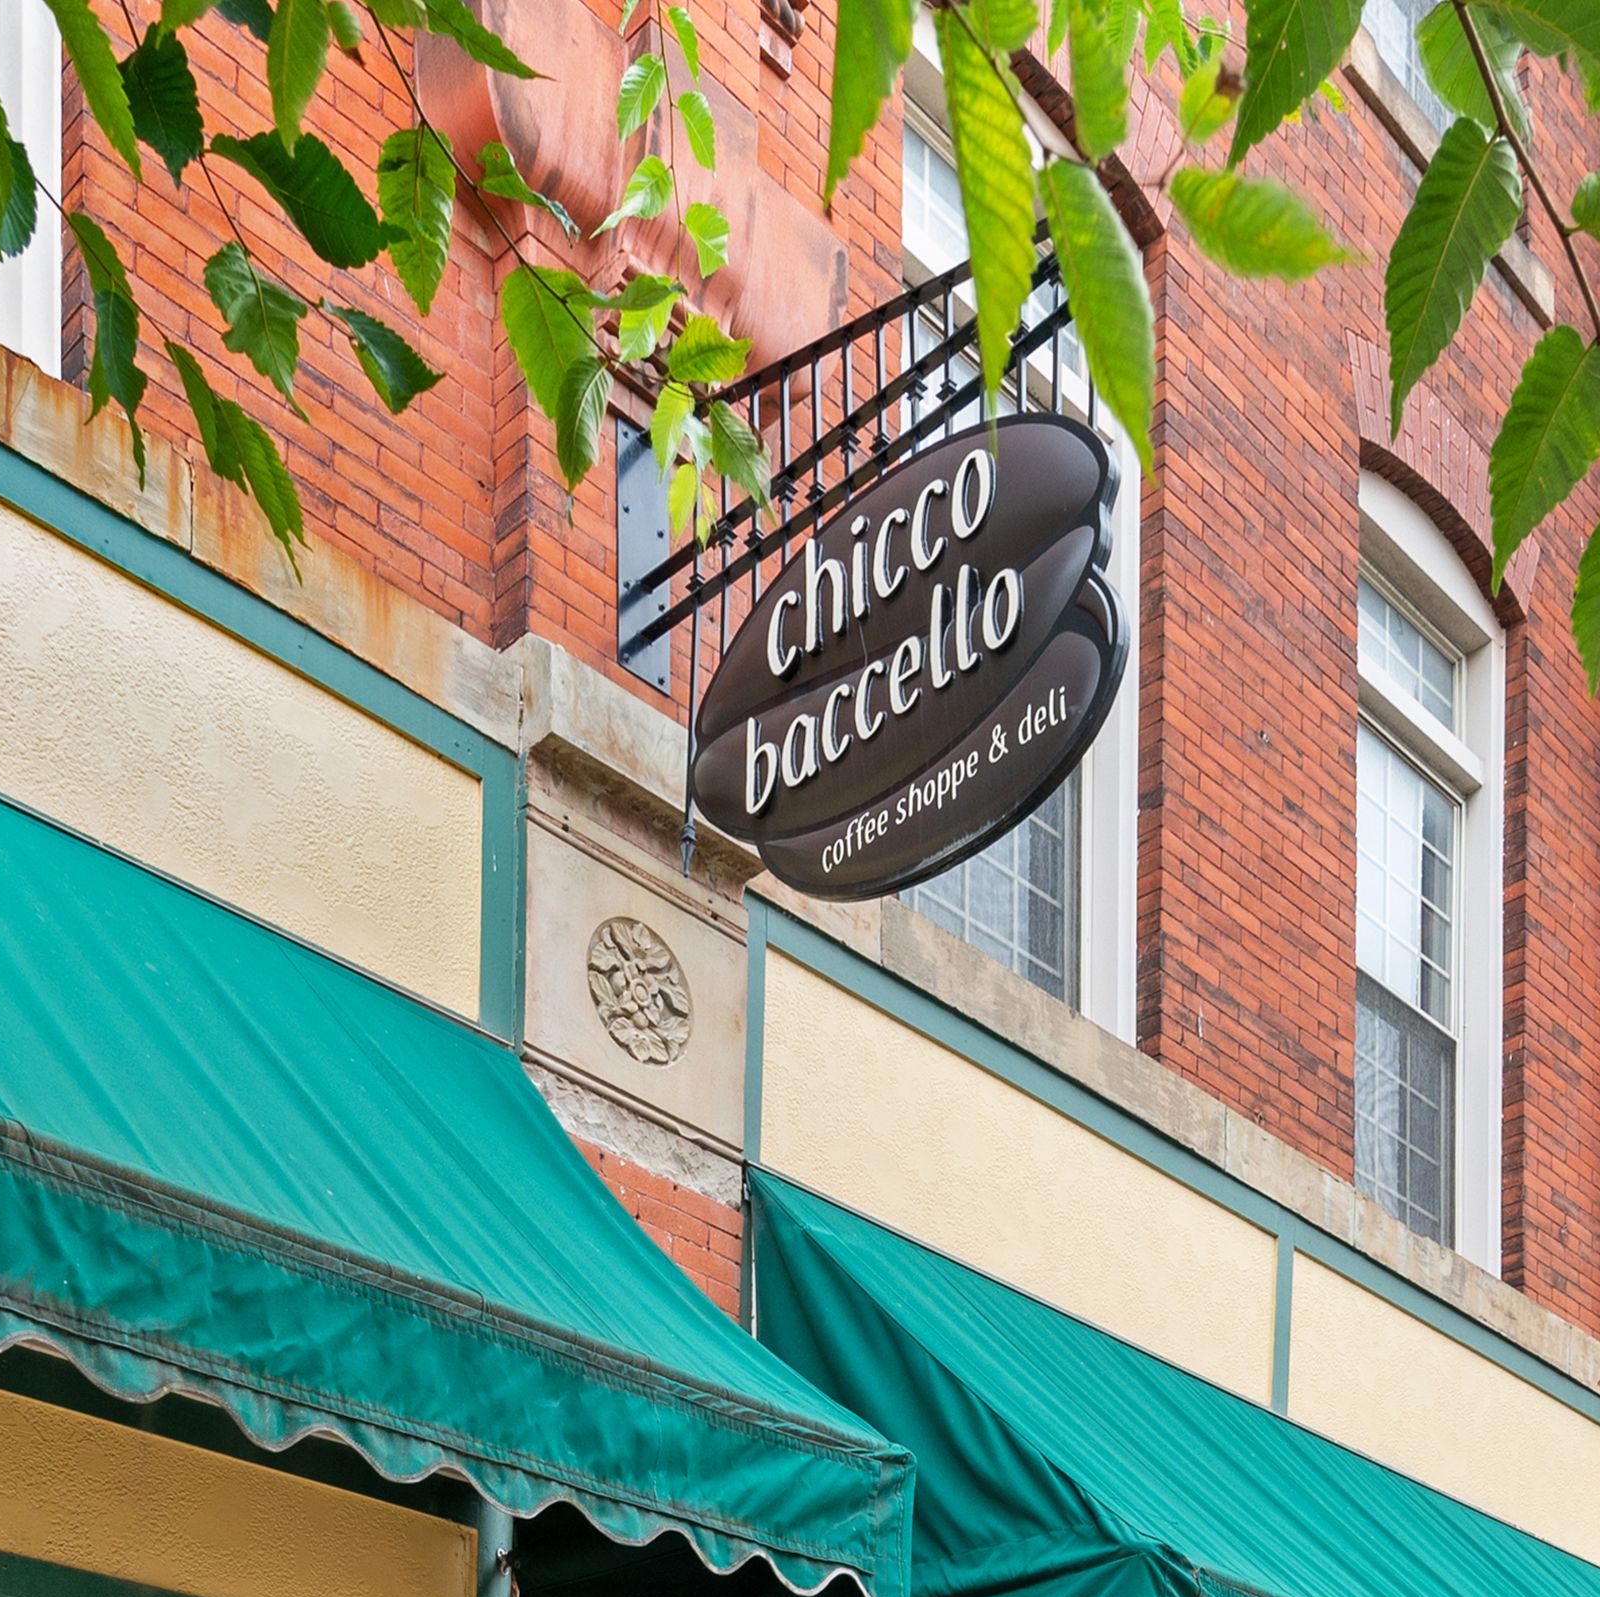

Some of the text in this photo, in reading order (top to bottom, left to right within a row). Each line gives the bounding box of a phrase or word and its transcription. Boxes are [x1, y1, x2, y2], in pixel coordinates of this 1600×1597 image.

[766, 447, 995, 679] chicco
[746, 564, 1023, 816] baccello
[821, 686, 1067, 873] coffee shoppe & deli
